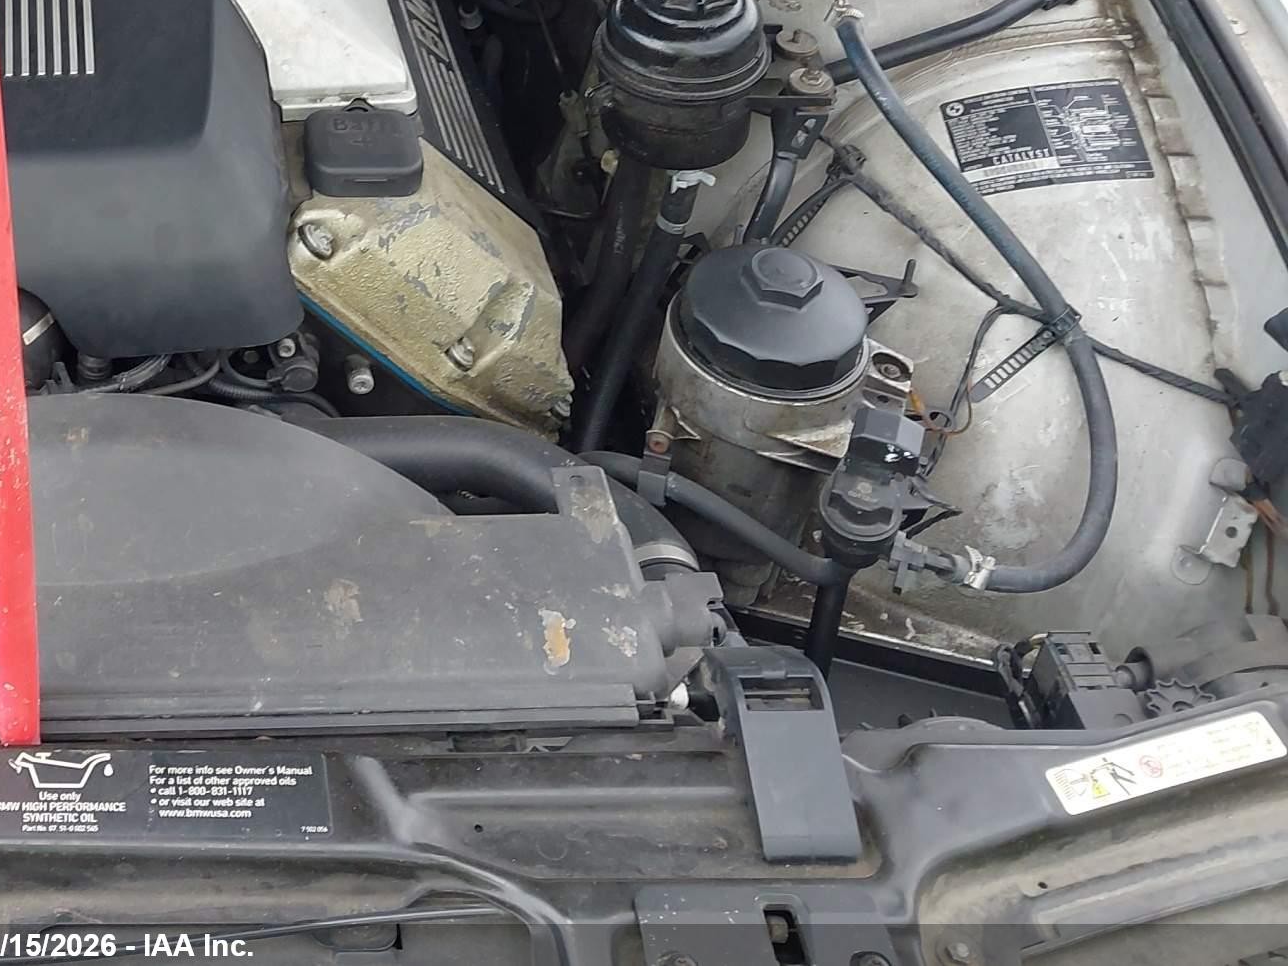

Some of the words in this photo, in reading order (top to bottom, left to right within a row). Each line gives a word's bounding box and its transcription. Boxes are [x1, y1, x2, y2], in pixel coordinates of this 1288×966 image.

[992, 148, 1050, 166] CATALYST
[149, 765, 166, 775] For
[168, 766, 194, 775] more
[195, 765, 214, 775] info
[215, 766, 233, 775] see
[276, 766, 313, 776] Manual
[149, 775, 167, 785] For
[168, 777, 175, 785] a
[176, 775, 192, 785] list
[193, 775, 203, 785] of
[204, 775, 231, 786] other
[232, 776, 278, 788] approved
[279, 776, 297, 786] oils
[158, 786, 177, 796] call
[178, 786, 254, 796] 1-800-831-1117
[38, 791, 59, 801] Use
[60, 791, 82, 803] only
[158, 798, 170, 807] or
[171, 797, 192, 807] visit
[193, 798, 211, 807] our
[213, 797, 234, 807] web
[235, 797, 254, 807] site
[255, 798, 265, 807] at
[22, 802, 48, 811] HIGH
[49, 802, 127, 812] PERFORMANCE
[23, 813, 79, 823] SYNTHETIC
[80, 813, 98, 823] OIL
[158, 809, 252, 818] www.bmwusa.com
